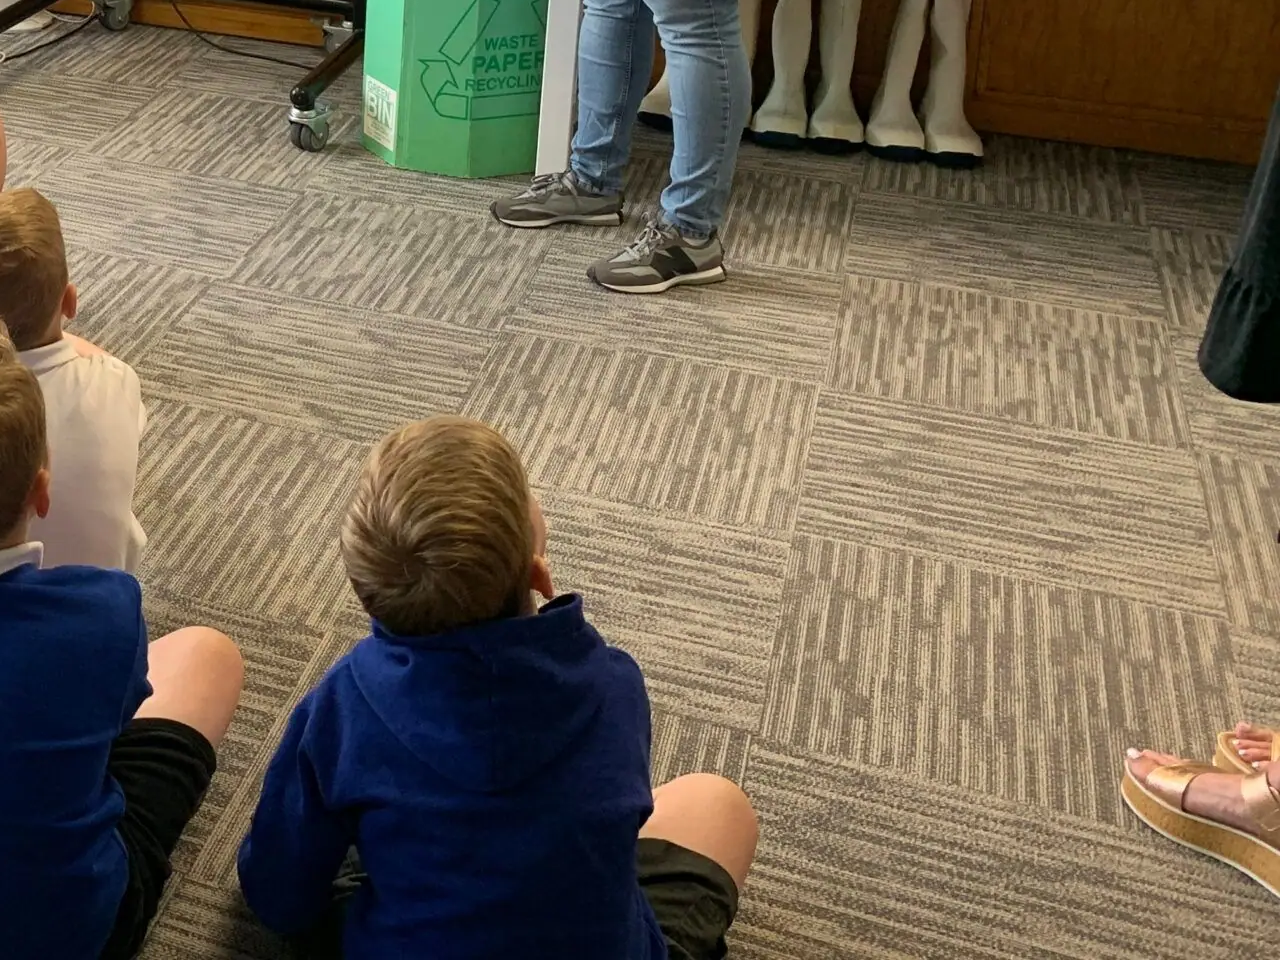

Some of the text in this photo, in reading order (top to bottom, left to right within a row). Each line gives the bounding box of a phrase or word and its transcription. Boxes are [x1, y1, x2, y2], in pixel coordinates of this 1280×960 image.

[484, 34, 538, 51] WASTE
[465, 73, 542, 92] RECYCLIN
[367, 93, 394, 130] BIN
